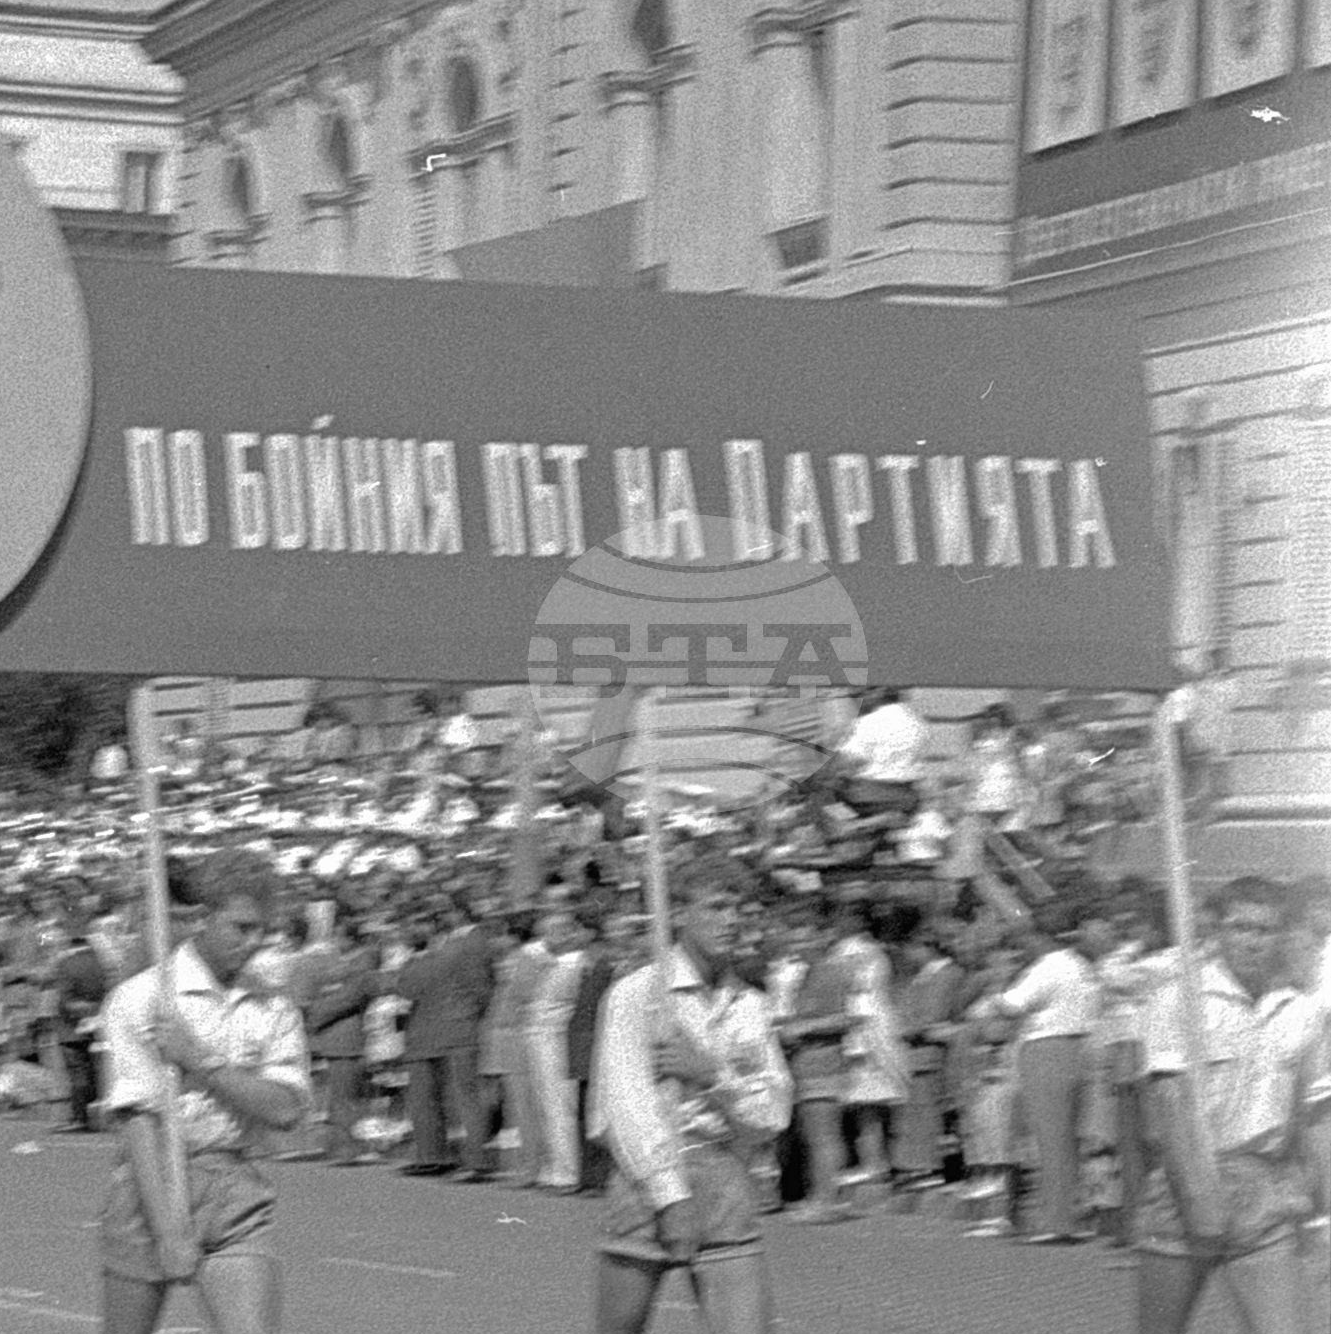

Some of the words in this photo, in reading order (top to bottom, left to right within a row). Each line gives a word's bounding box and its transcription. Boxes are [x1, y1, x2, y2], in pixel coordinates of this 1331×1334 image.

[124, 427, 209, 547] ПО
[221, 414, 464, 555] БОЙНИЯ
[480, 442, 588, 557] ПЪТ
[613, 446, 706, 562] НА
[722, 439, 1116, 568] ПАРТИЯТА
